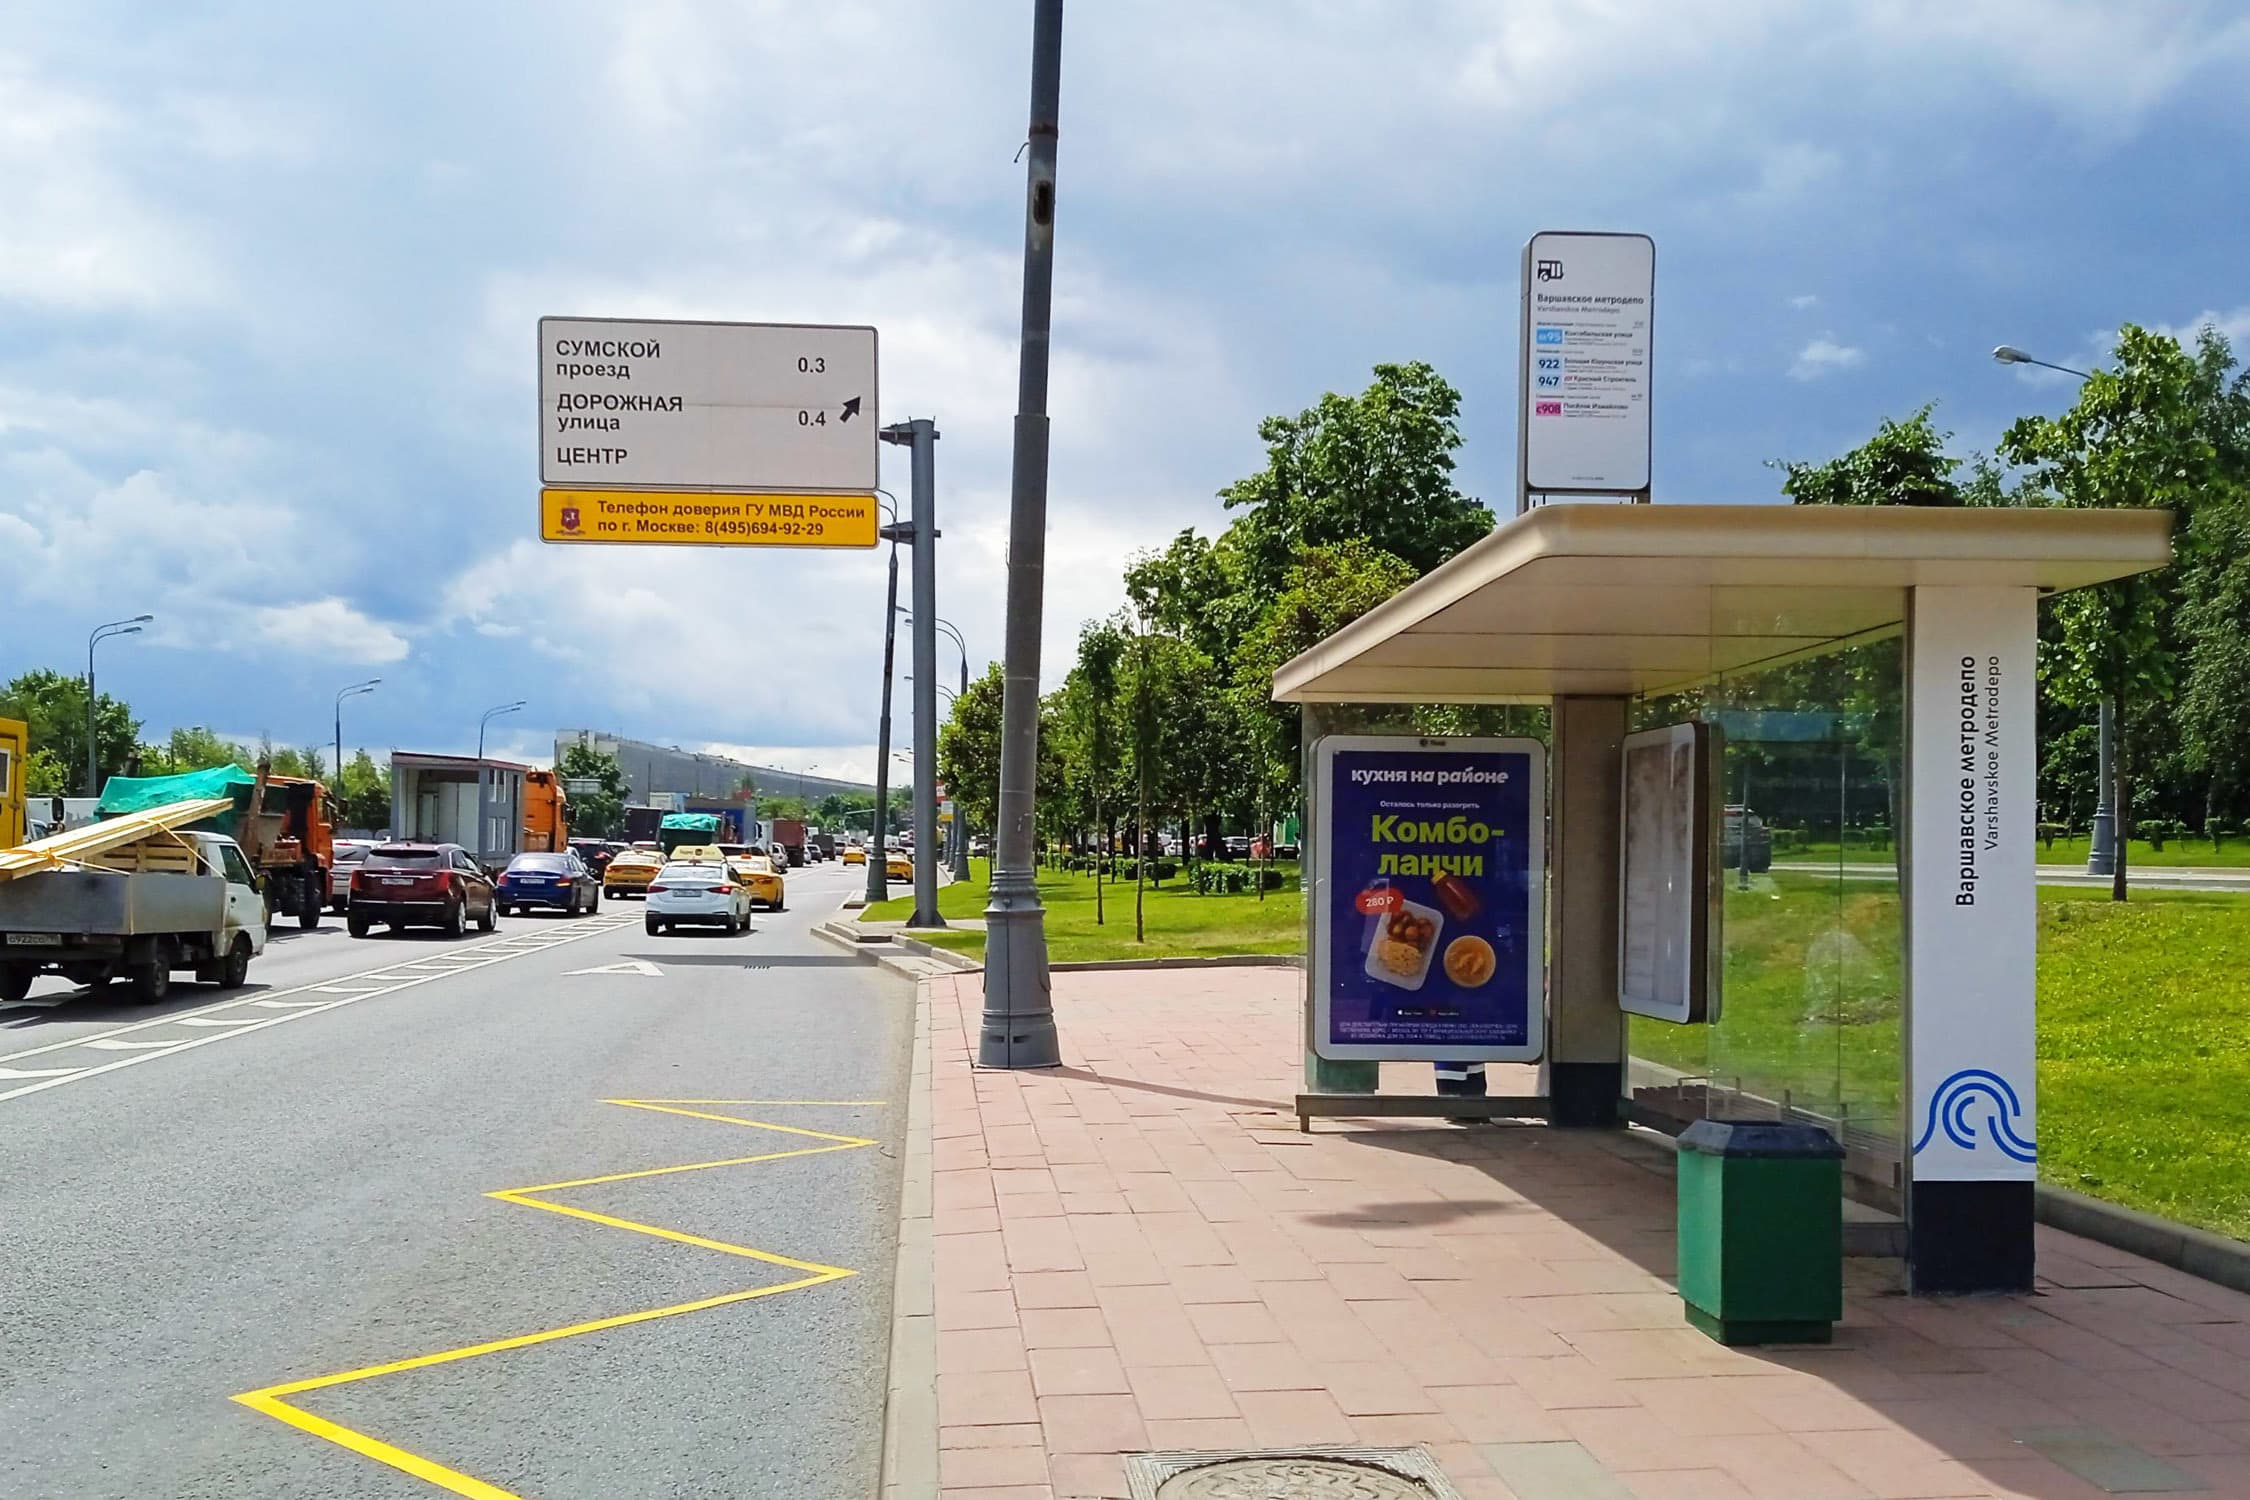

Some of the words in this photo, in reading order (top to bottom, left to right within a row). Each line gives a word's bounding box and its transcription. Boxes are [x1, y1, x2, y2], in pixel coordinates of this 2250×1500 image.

[1594, 295, 1644, 305] метродепо
[556, 339, 661, 359] СУМСКОЙ
[556, 363, 630, 380] проезд
[797, 357, 826, 373] 0.3
[1538, 359, 1559, 370] 922
[1538, 376, 1559, 387] 947
[556, 393, 683, 413] ДОРОЖНАЯ
[557, 416, 621, 433] улица
[798, 411, 826, 427] 0.4
[556, 448, 628, 466] ЦЕНТР
[598, 501, 668, 518] Телефон
[672, 504, 740, 519] доверия
[745, 504, 765, 518] ГУ
[768, 504, 804, 519] МВД
[808, 505, 865, 519] России
[598, 521, 618, 534] по
[622, 522, 632, 533] г.
[636, 520, 700, 534] Москве:
[705, 520, 824, 537] 8(495)694-92-29
[1984, 656, 2002, 747] Metrodepo
[1961, 656, 1979, 772] метродепо
[1351, 769, 1407, 785] кухня
[1410, 772, 1435, 783] на
[1437, 766, 1509, 786] районе
[1416, 801, 1442, 809] только
[1984, 752, 1999, 850] Varshavskoe
[1371, 814, 1505, 844] Комбо-
[1955, 778, 1979, 906] Варшавское
[1377, 852, 1484, 877] ланчи
